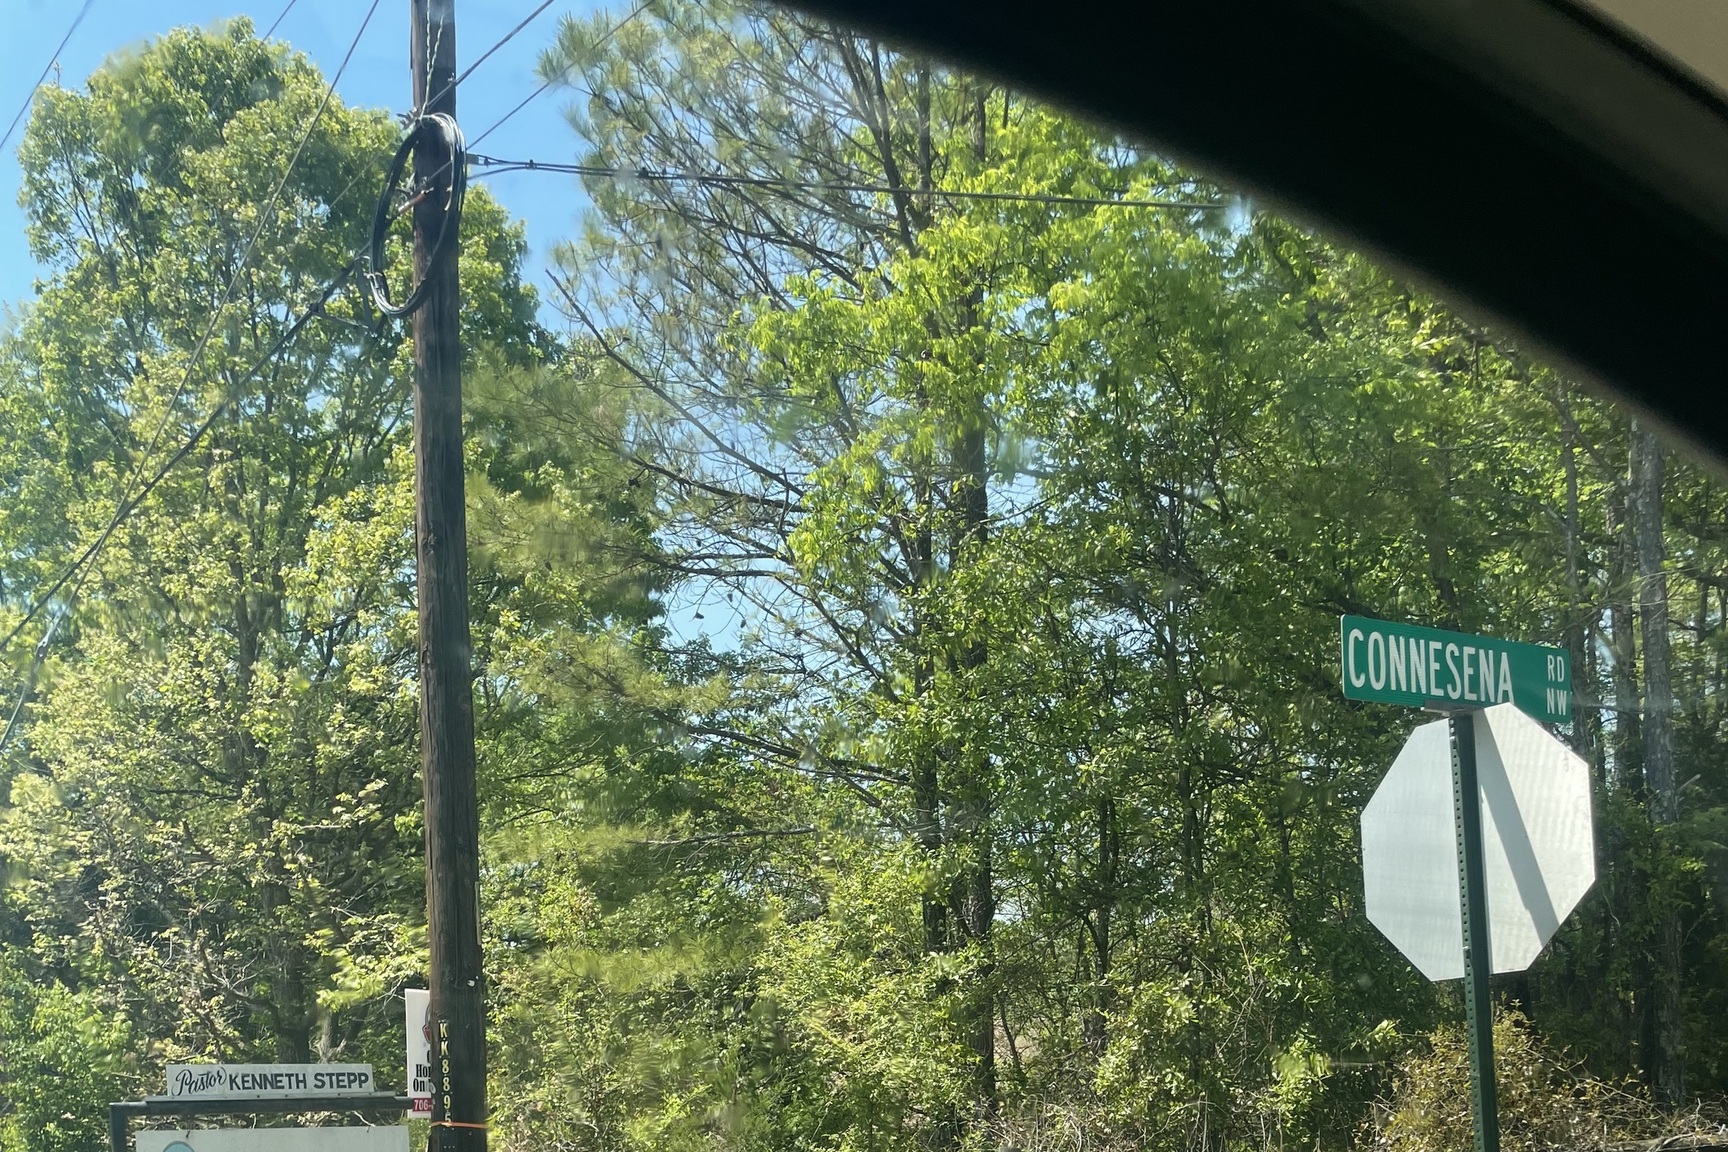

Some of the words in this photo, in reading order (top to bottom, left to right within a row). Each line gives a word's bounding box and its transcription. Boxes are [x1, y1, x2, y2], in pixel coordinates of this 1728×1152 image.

[1348, 628, 1515, 704] CONNESENA
[1547, 654, 1565, 683] RD
[1547, 687, 1568, 716] NW
[171, 1066, 228, 1097] Pastor
[229, 1072, 307, 1091] KENNETH
[313, 1072, 369, 1090] STEPP
